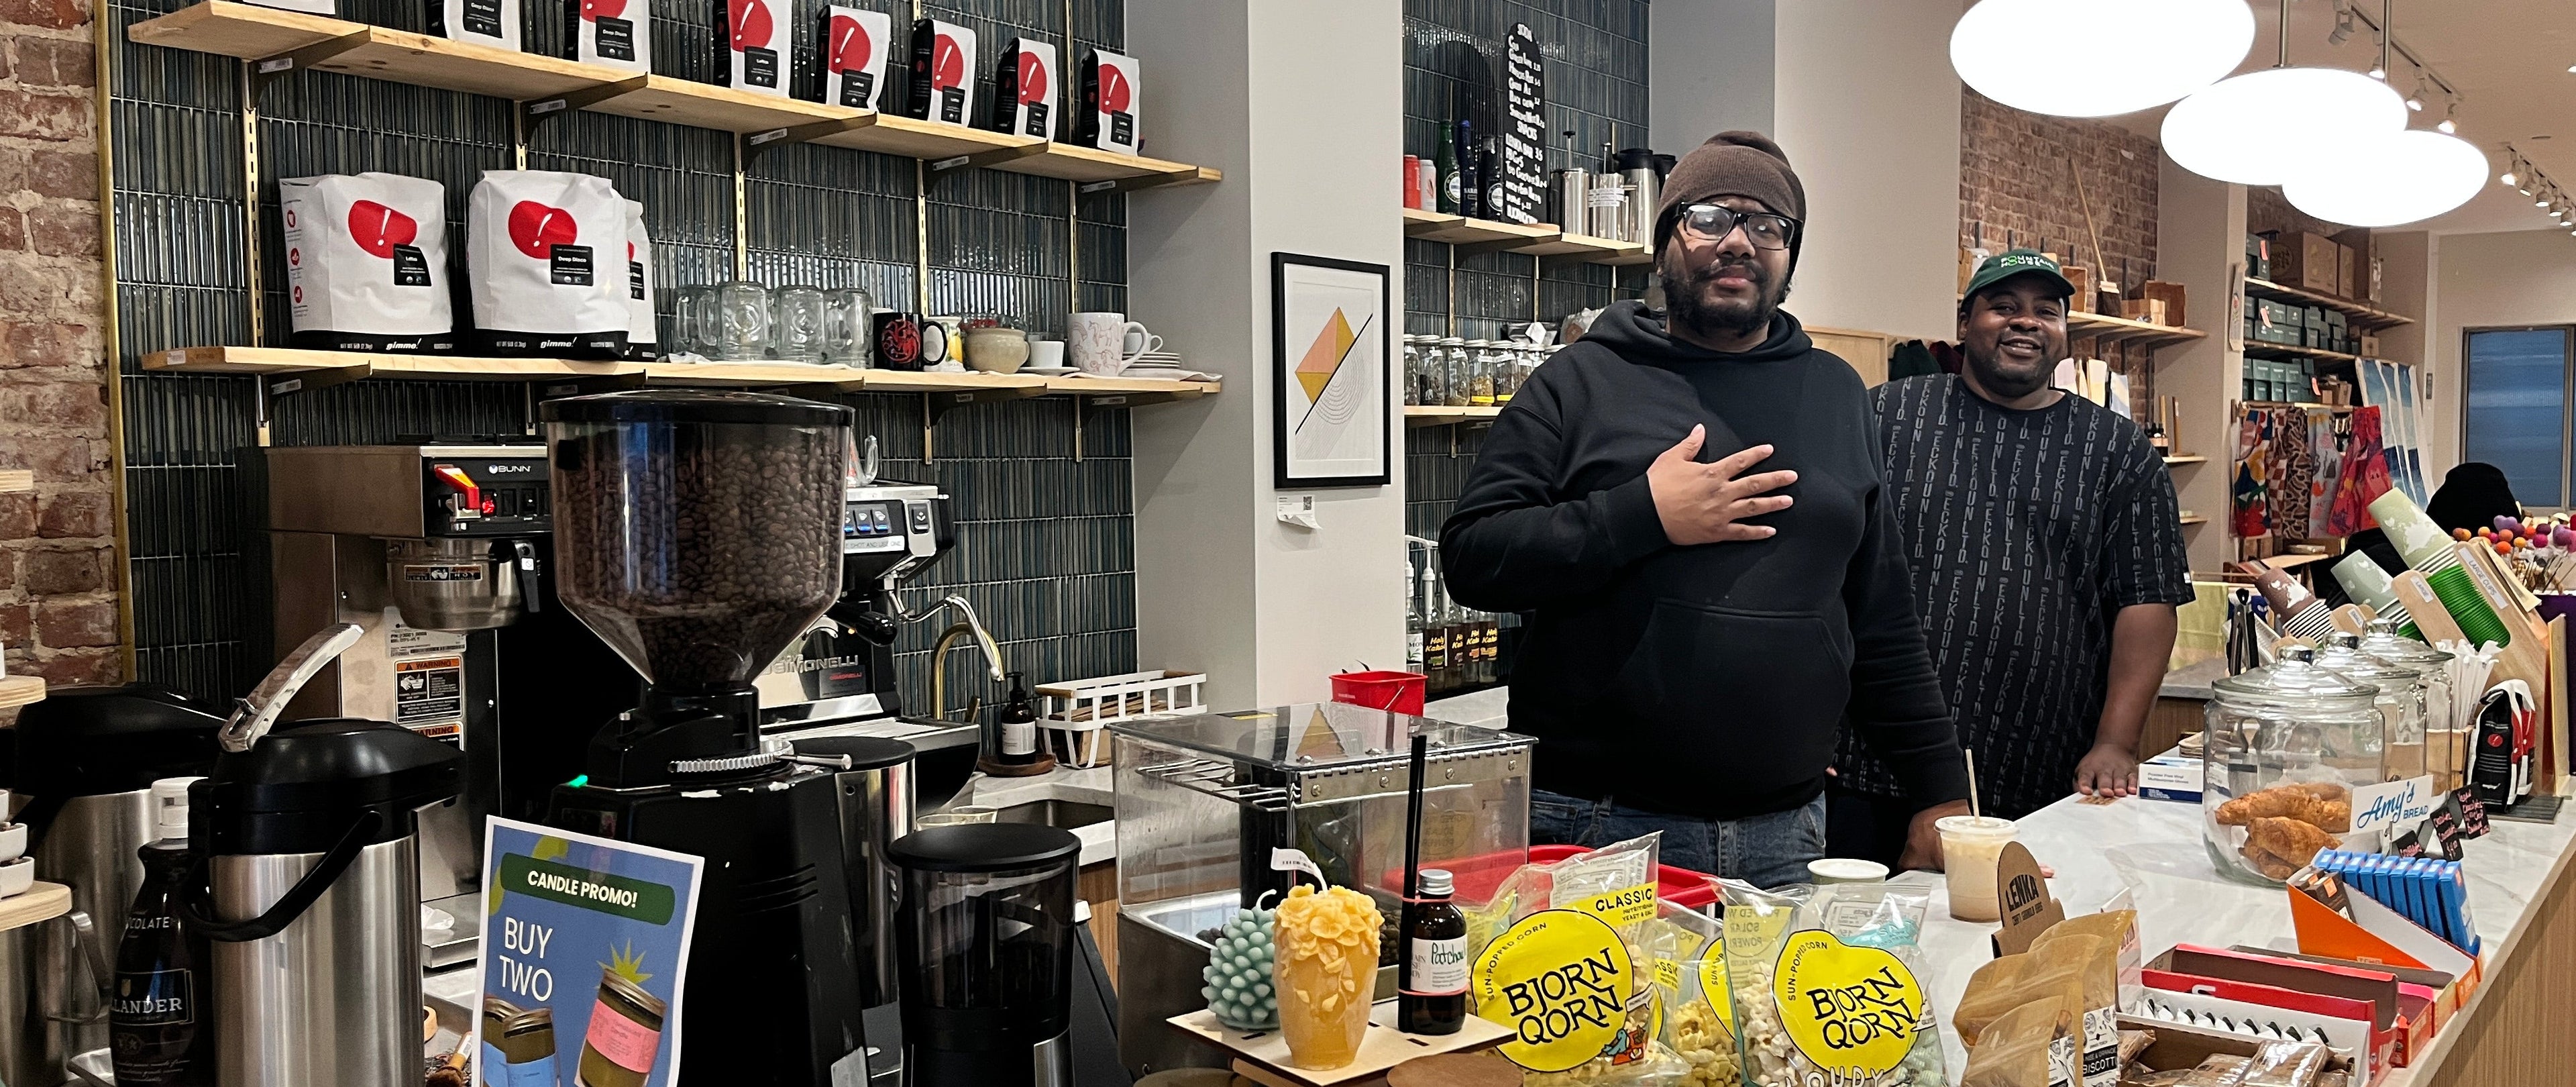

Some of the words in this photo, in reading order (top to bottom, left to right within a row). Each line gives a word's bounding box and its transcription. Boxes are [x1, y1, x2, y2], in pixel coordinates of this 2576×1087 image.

[498, 464, 531, 474] BUNN
[2469, 560, 2483, 578] LARGE
[2483, 577, 2498, 597] CUPS
[415, 659, 451, 670] WARNING
[416, 725, 454, 737] ARNING
[2357, 781, 2415, 829] Amy's
[2403, 805, 2428, 820] BREAD
[527, 870, 578, 896] CANDLE
[580, 882, 638, 909] PROMO!
[1595, 888, 1653, 913] CLASSIC
[2006, 874, 2039, 913] LENKA
[504, 917, 553, 960] BUY
[499, 955, 553, 1002] TWO
[1488, 940, 1515, 1002] SUN-POPPED
[1517, 922, 1547, 941] CORN
[1502, 947, 1619, 1017] BJORN
[1788, 944, 1807, 1001] SUN-POPPED
[1805, 941, 1828, 951] CORN
[1519, 984, 1623, 1045] QORN
[1806, 966, 1904, 1023] BJORN
[1822, 997, 1916, 1049] QORN
